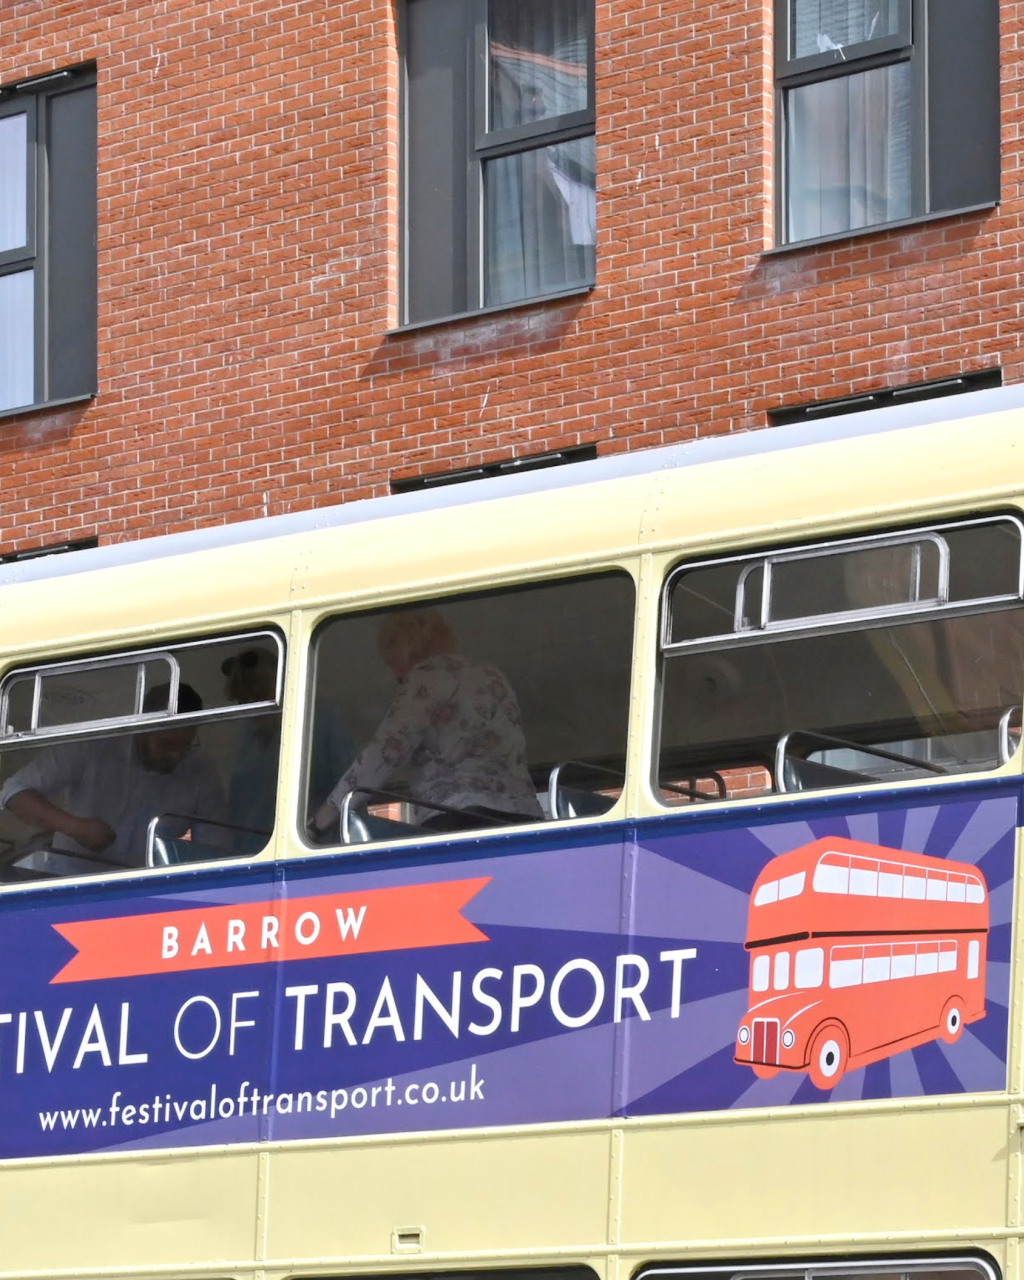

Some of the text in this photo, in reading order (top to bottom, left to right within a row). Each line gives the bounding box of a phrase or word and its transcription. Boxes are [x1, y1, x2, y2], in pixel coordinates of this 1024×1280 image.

[161, 906, 367, 959] BARROW
[174, 990, 259, 1060] OF
[285, 948, 697, 1050] TRANSPORT
[39, 1064, 485, 1131] www.festivaloftransport.co.uk
